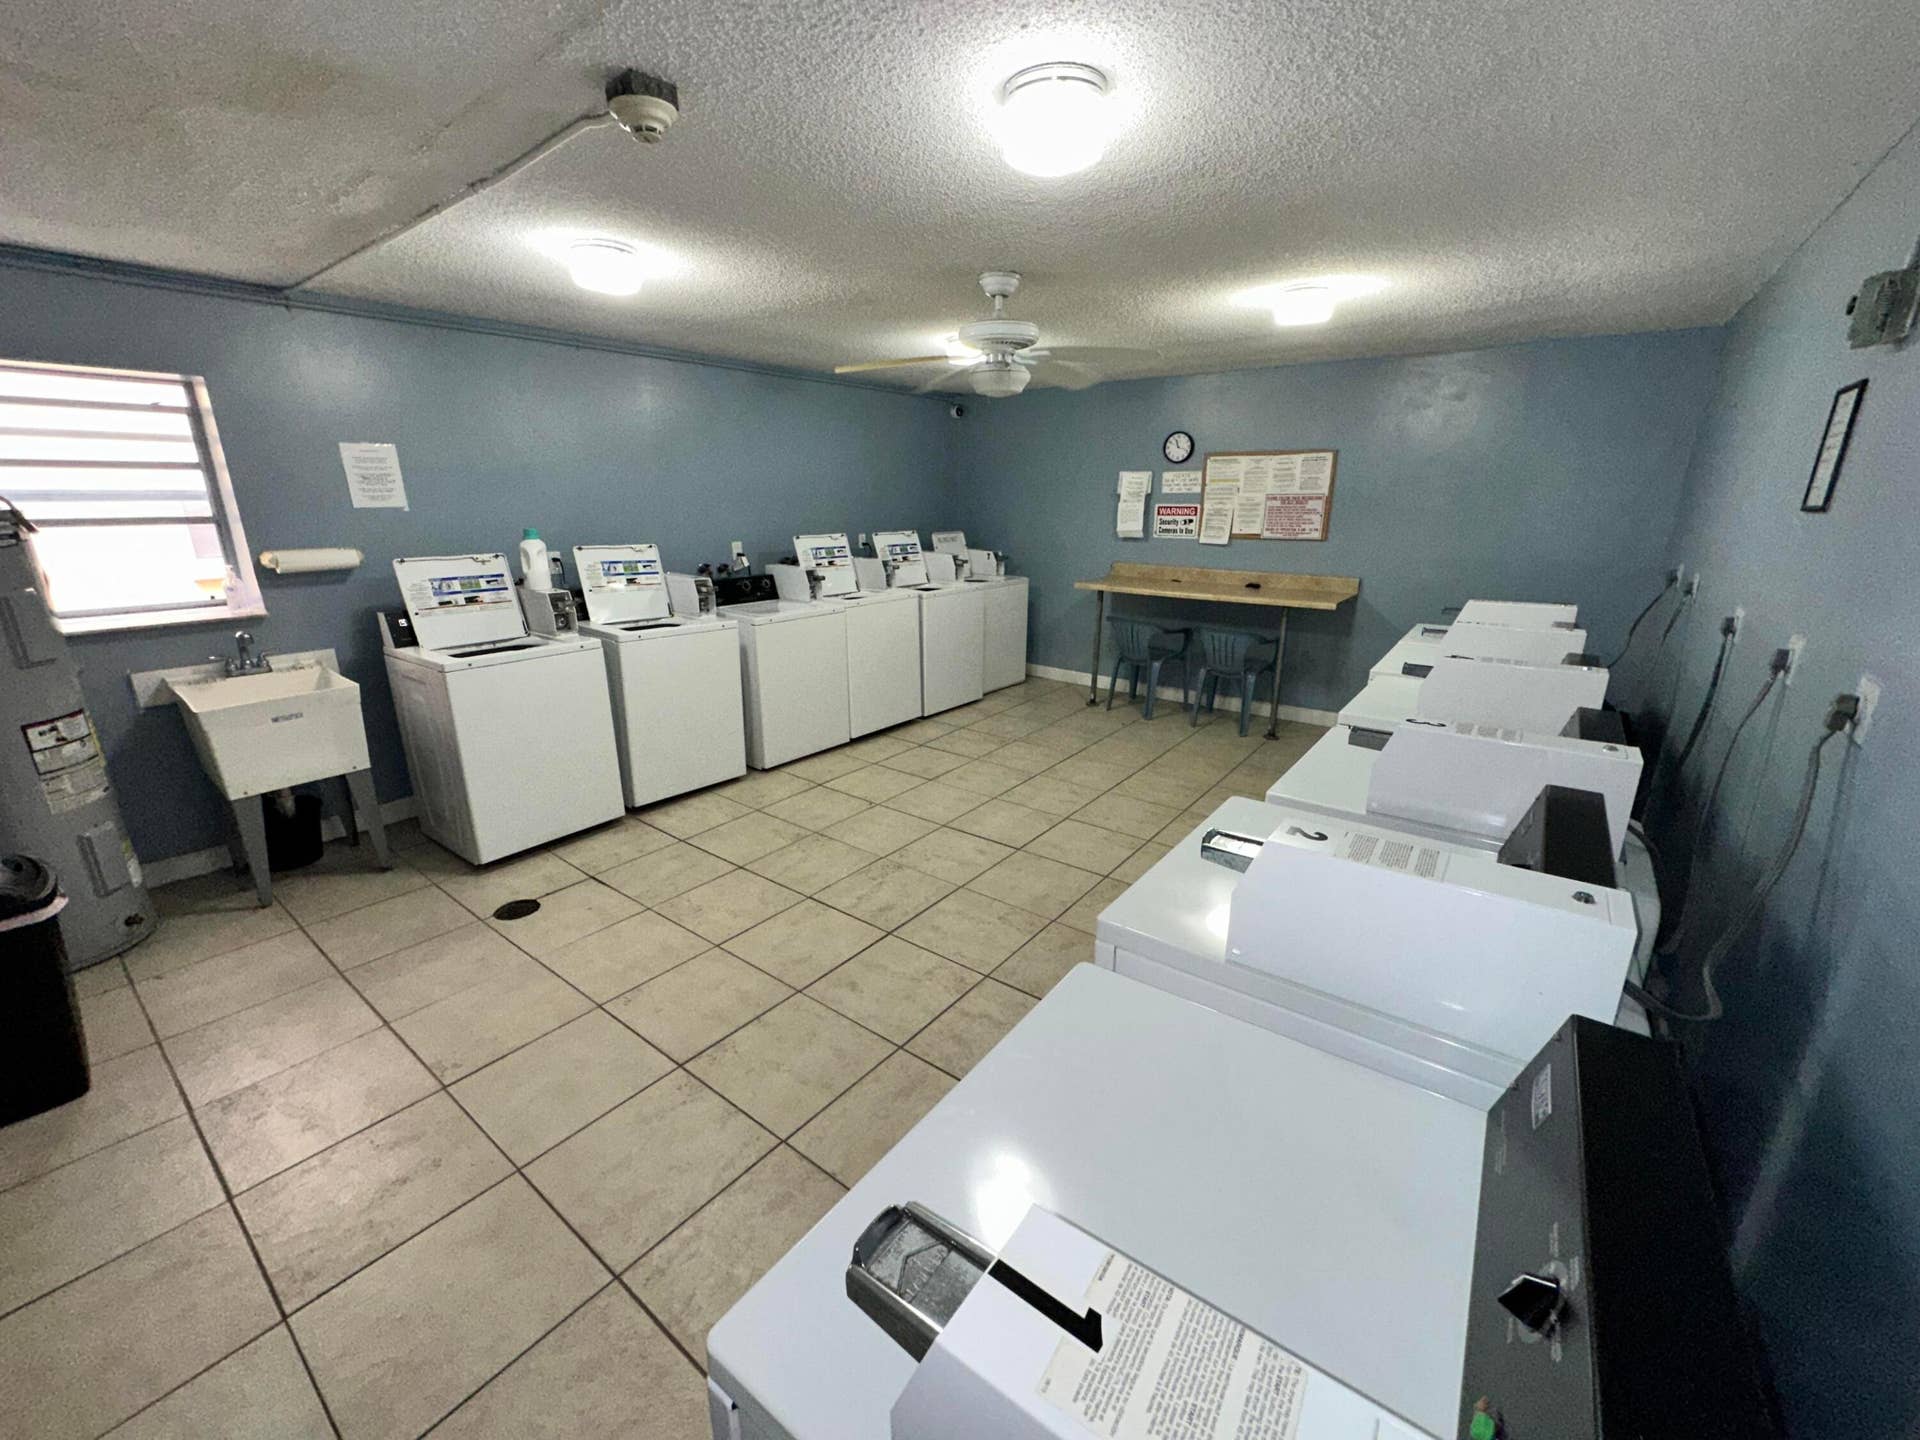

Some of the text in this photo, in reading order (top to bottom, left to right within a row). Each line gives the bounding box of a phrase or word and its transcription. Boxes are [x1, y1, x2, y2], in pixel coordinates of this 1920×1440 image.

[1159, 507, 1196, 515] WARNING
[1159, 518, 1179, 526] Security
[1158, 526, 1178, 534] Cameras
[1286, 825, 1329, 842] 2
[988, 1258, 1104, 1354] 1
